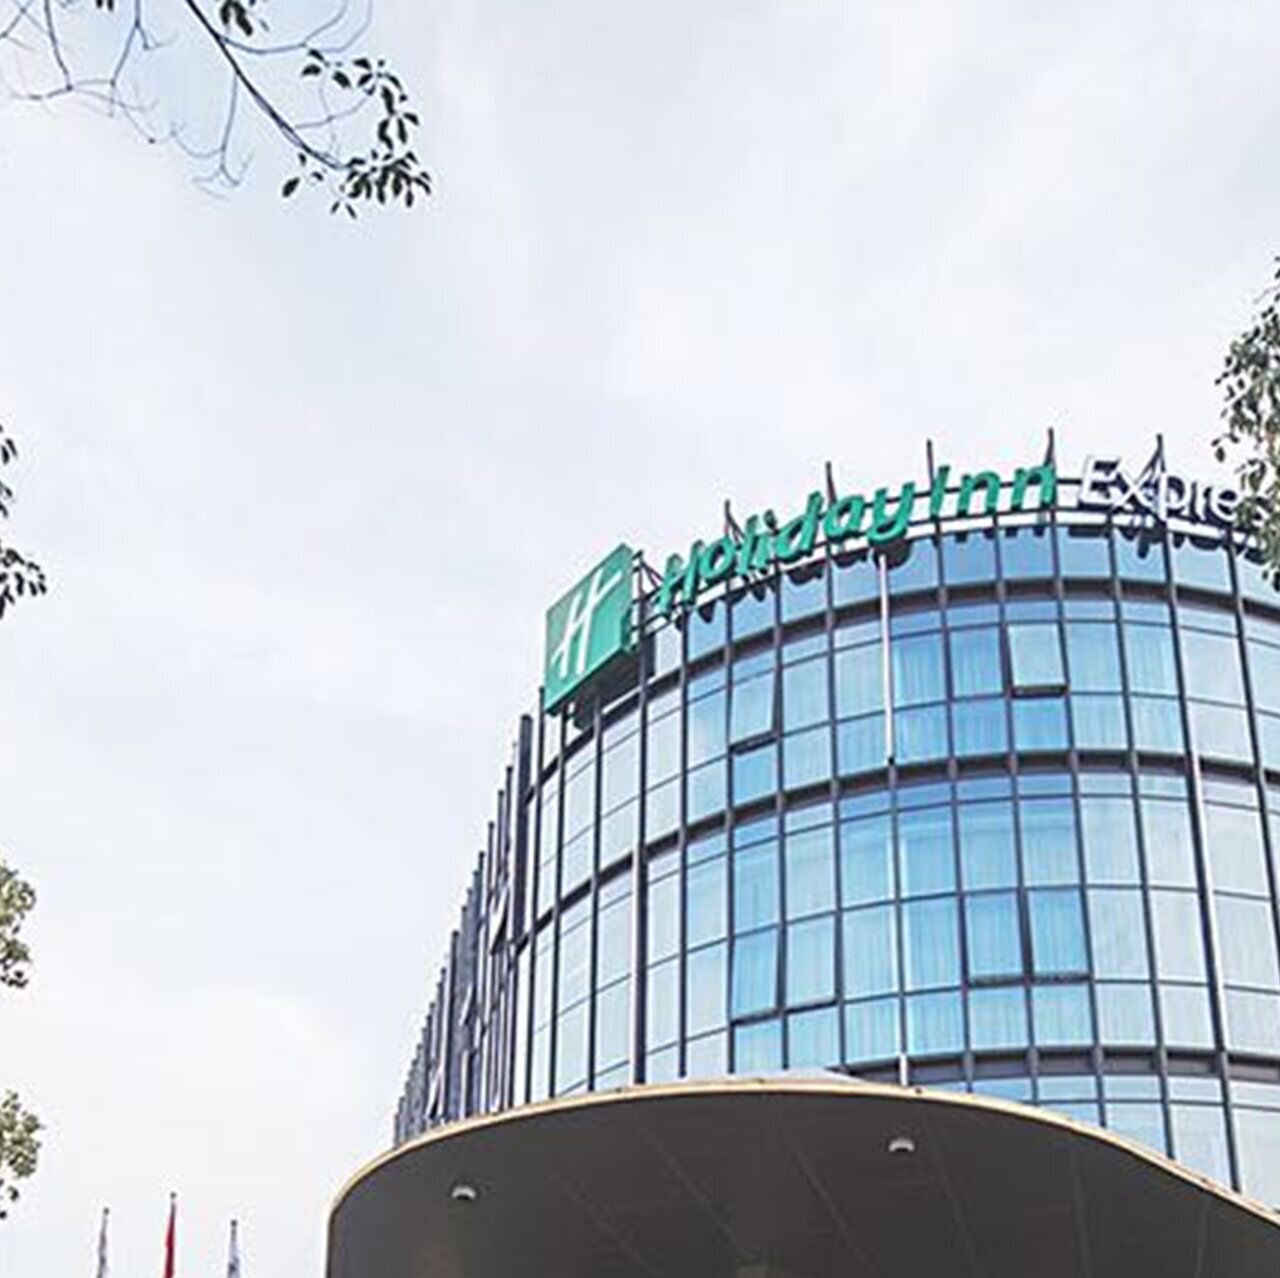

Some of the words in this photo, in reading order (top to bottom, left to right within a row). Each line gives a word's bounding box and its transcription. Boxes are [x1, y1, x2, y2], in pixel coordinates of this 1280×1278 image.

[654, 480, 916, 618] Holiday
[930, 463, 1059, 519] Inn
[1079, 455, 1272, 526] Expre
